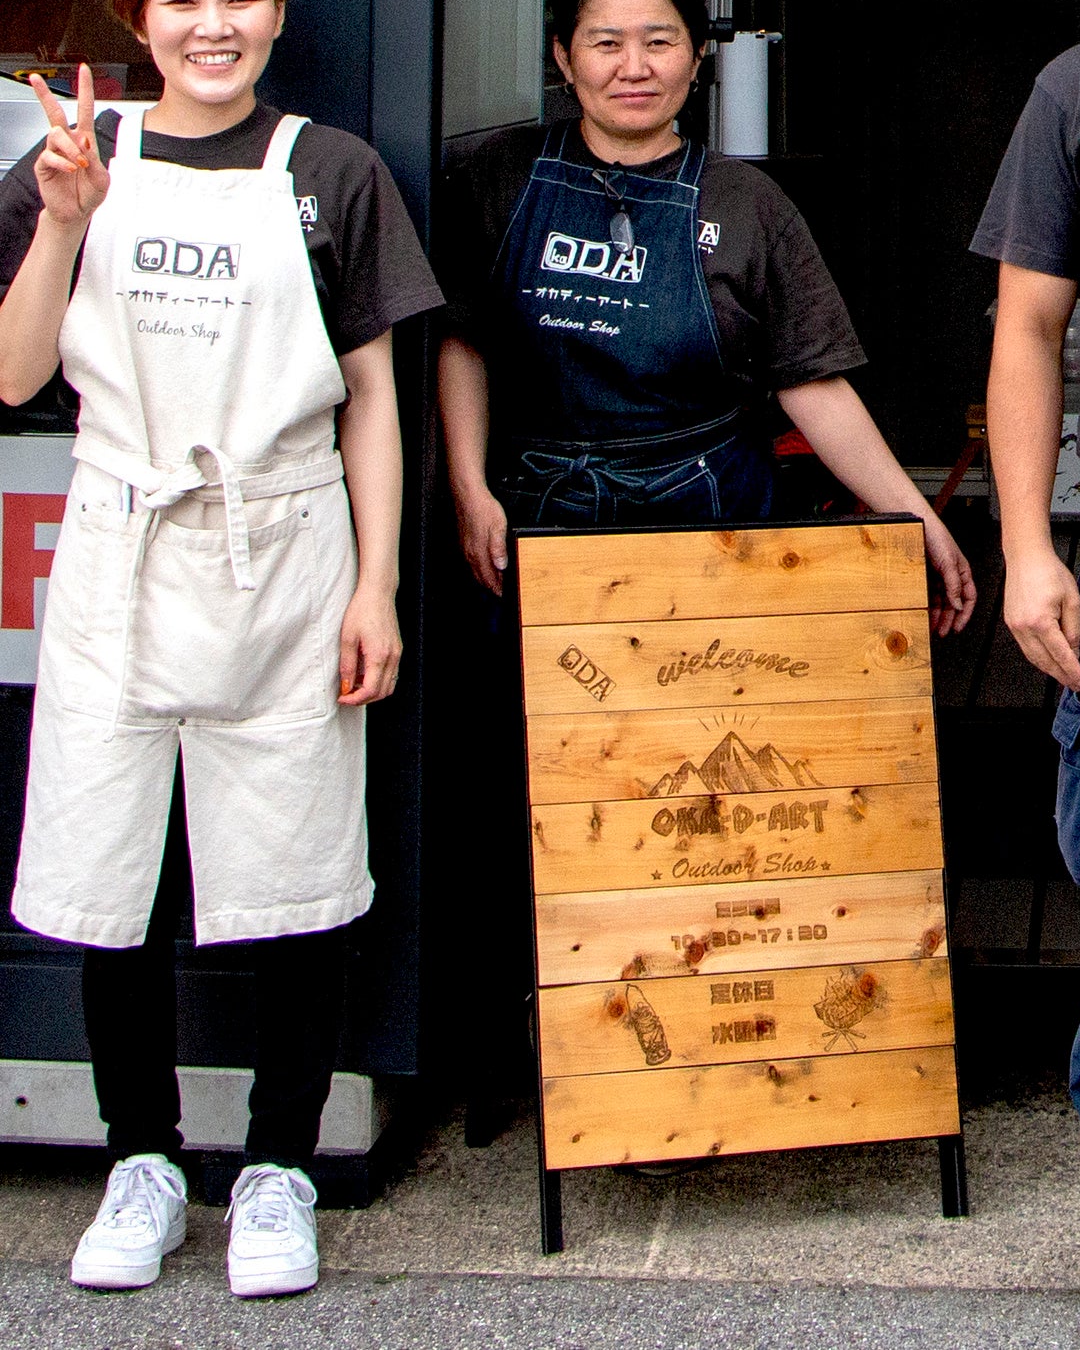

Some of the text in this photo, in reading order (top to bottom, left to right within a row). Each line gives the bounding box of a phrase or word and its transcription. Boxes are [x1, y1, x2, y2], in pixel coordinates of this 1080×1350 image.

[535, 287, 633, 310] オカディーアート
[137, 319, 222, 346] Outdoor Shop
[538, 314, 621, 336] Outdoor Shop
[656, 638, 810, 687] welcome
[651, 800, 829, 837] OKA-D-ART
[672, 852, 818, 879] Outdoor Shop
